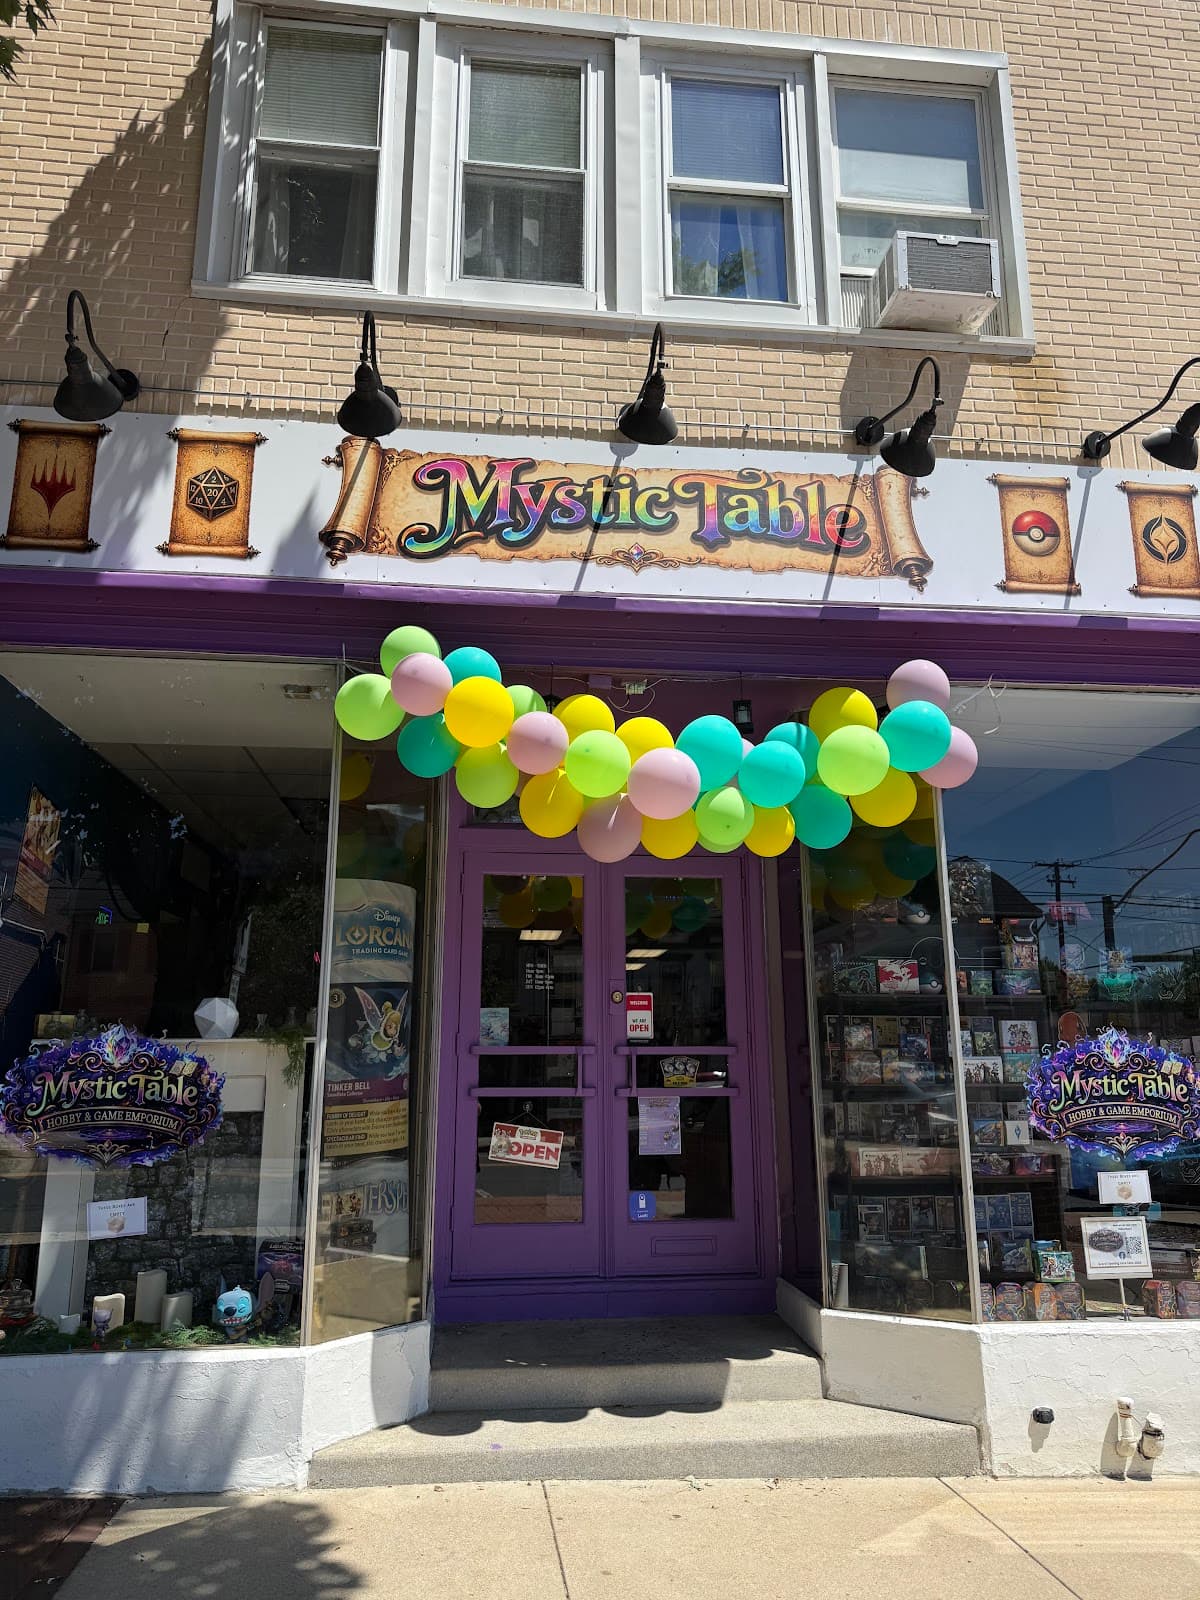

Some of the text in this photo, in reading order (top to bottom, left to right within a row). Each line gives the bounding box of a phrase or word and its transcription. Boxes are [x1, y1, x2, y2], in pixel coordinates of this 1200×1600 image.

[207, 488, 218, 497] 20
[399, 458, 868, 557] Mystic Table
[373, 908, 401, 926] Disney
[629, 1024, 649, 1033] OPEN
[27, 1070, 198, 1116] Mystic Table
[327, 1081, 370, 1092] TINKER BELL
[1050, 1069, 1189, 1112] Mystic Table
[47, 1110, 179, 1130] HOBBY & GAME EMPORIUM
[1068, 1106, 1178, 1124] HOBBY & GAME EMPORIUM
[509, 1142, 560, 1161] OPEN
